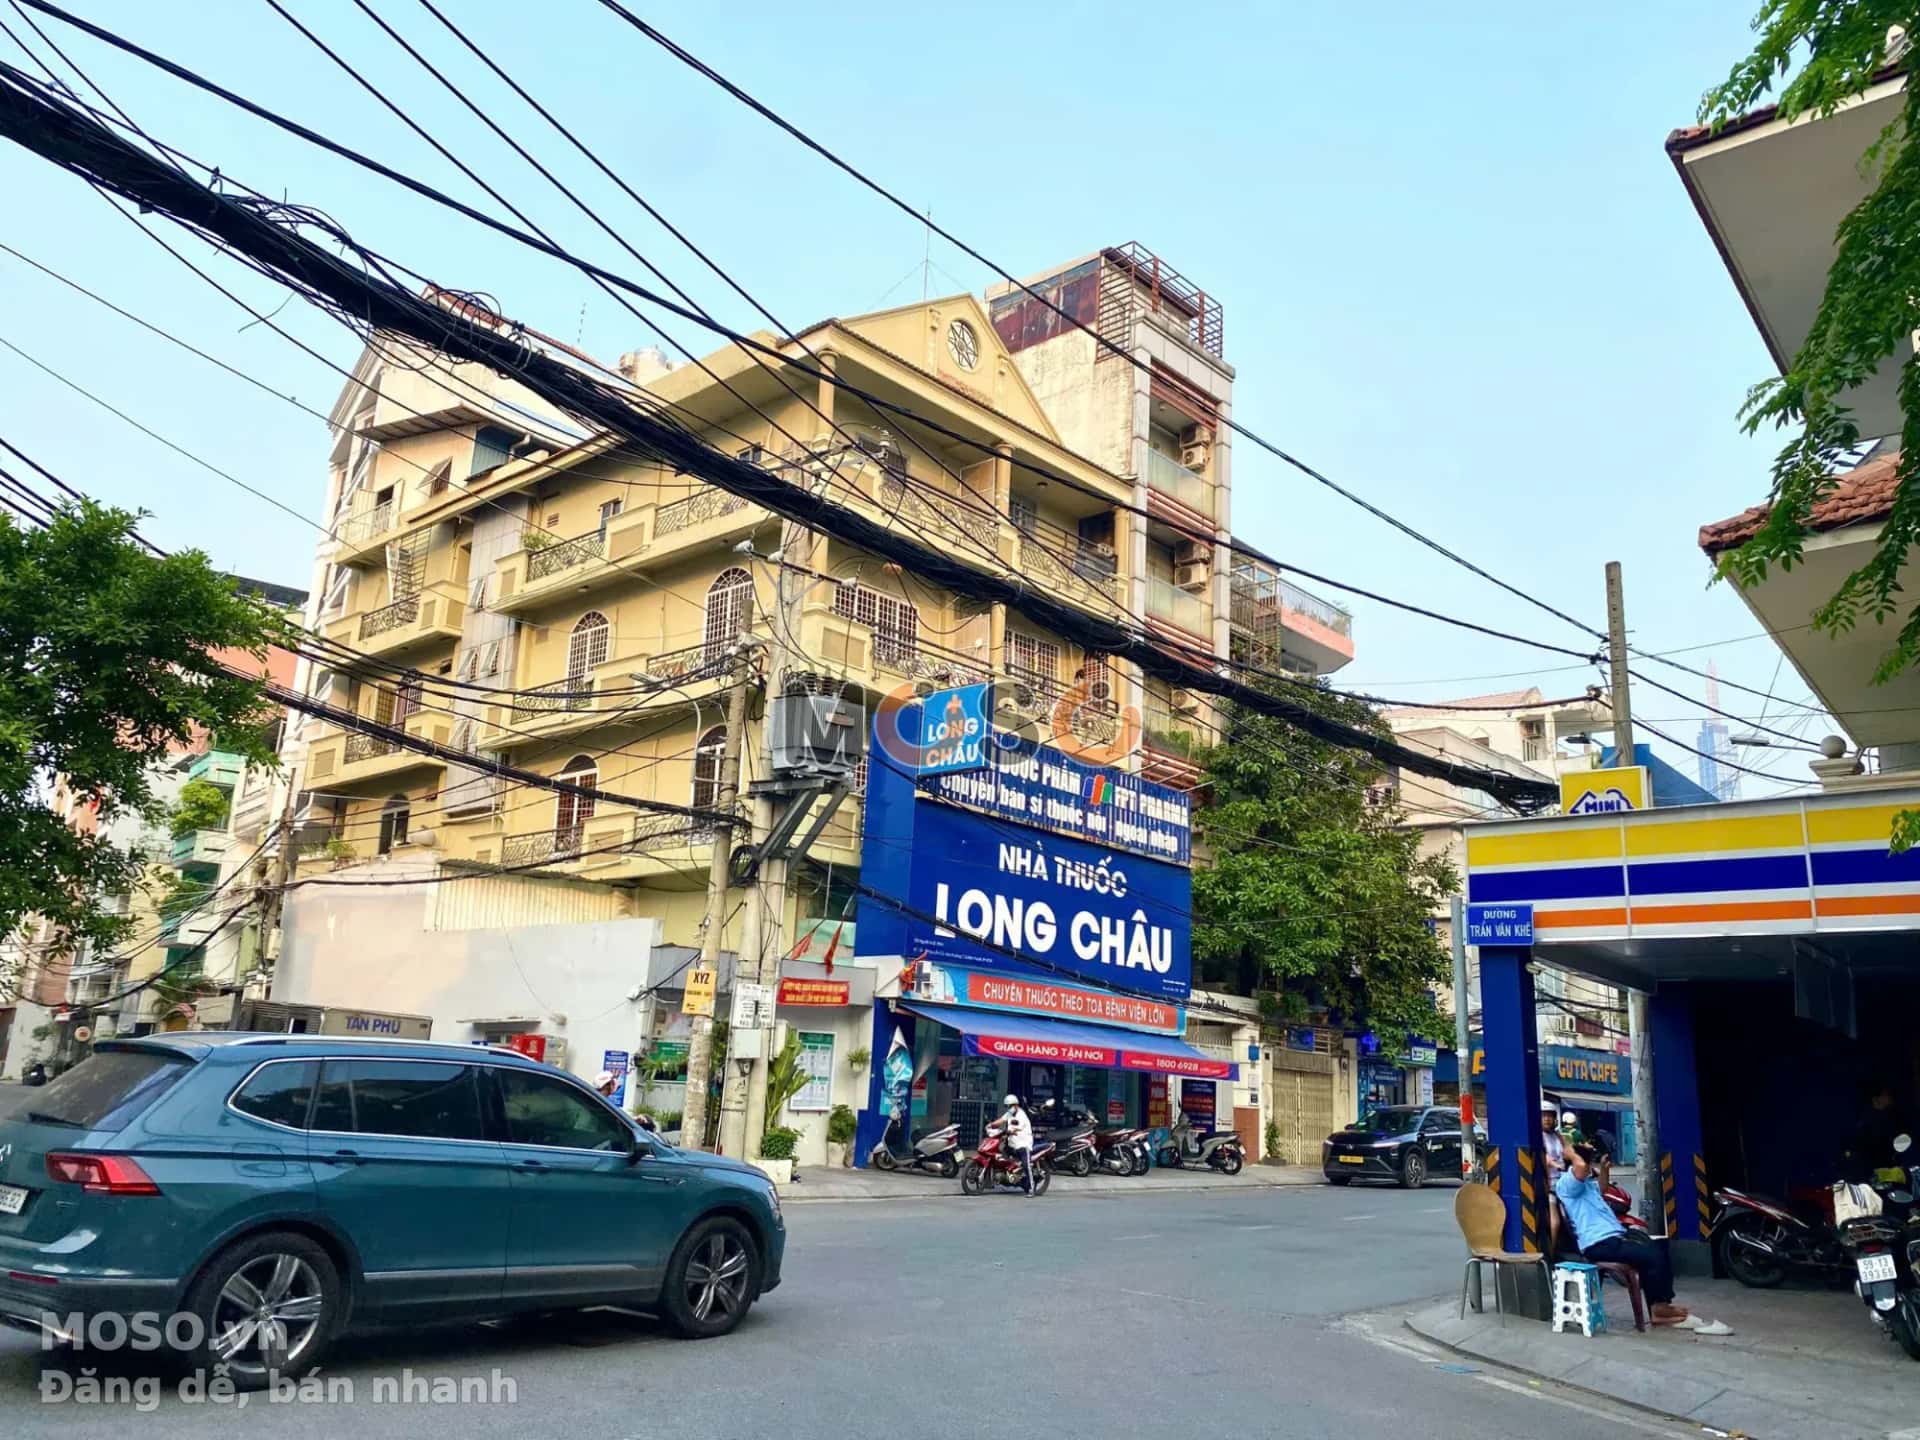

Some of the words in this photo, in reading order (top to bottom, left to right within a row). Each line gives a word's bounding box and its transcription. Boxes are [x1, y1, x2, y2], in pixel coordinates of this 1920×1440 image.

[927, 717, 979, 742] LONG
[925, 740, 979, 768] CHÂU
[1000, 783, 1026, 811] bán
[1047, 798, 1083, 826] thuốc
[1114, 785, 1137, 812] FPT
[1140, 792, 1189, 828] PHARMA
[1584, 799, 1621, 814] MINI
[999, 840, 1049, 881] NHÀ
[1054, 856, 1127, 898] THUỐC
[934, 882, 1057, 952] LONG
[1070, 909, 1172, 973] CHÂU
[1495, 922, 1511, 937] VĂN
[693, 972, 711, 985] XYZ
[983, 981, 1023, 1002] CHUYÊN
[1026, 986, 1057, 1007] THUỐC
[1060, 993, 1083, 1011] THEO
[1086, 998, 1103, 1013] TOA
[1105, 998, 1126, 1018] BỆNH
[1129, 1003, 1147, 1023] VIỆN
[993, 1041, 1025, 1053] GIAO
[1156, 1058, 1176, 1069] 1800
[1177, 1062, 1199, 1072] 6928
[1558, 1056, 1588, 1080] GUTA
[1590, 1061, 1618, 1085] CAFE
